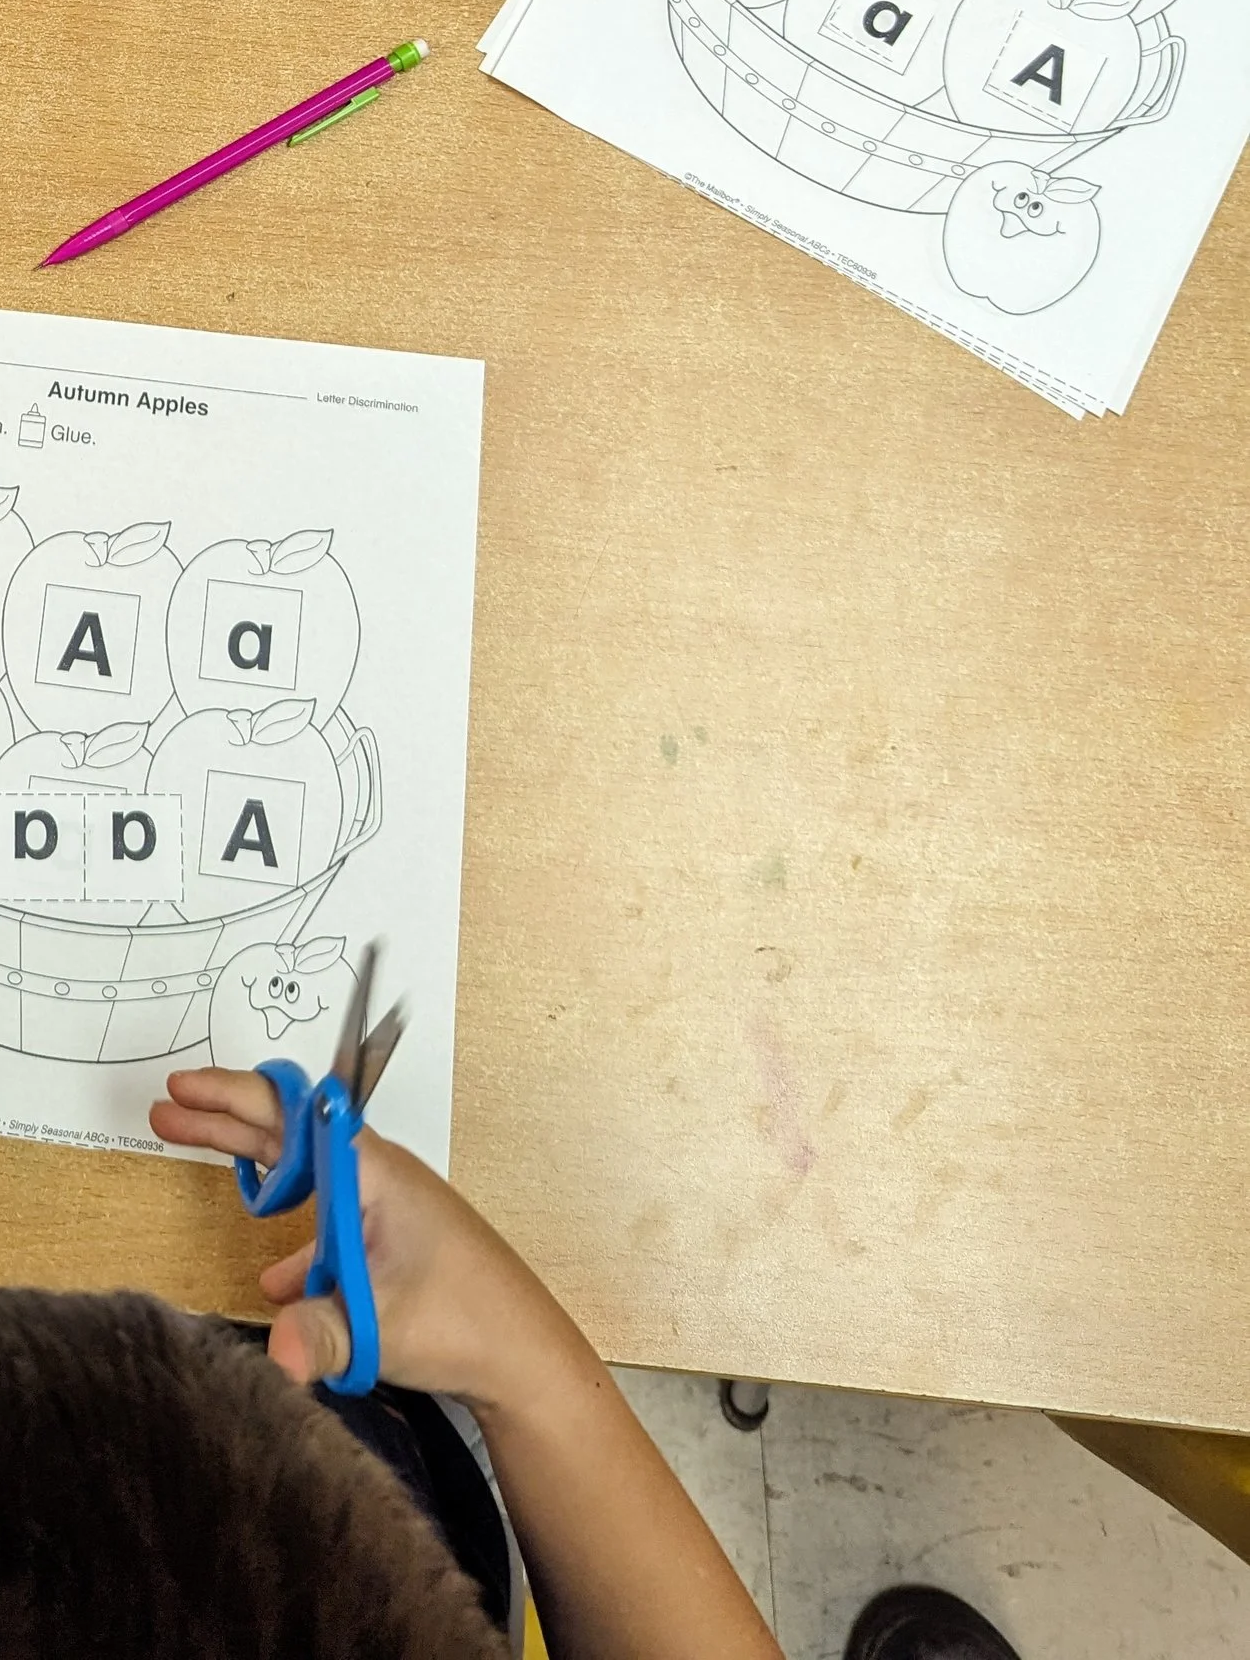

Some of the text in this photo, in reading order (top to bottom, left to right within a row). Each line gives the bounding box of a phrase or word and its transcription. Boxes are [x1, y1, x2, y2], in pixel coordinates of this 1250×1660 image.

[862, 0, 914, 47] a
[1010, 43, 1066, 106] A
[745, 204, 772, 224] Simply
[771, 220, 808, 244] Seasonal
[807, 236, 831, 255] ABCs
[48, 381, 209, 416] Autumn Apples
[316, 392, 419, 413] Letter Discrimination
[51, 424, 96, 445] Glue.
[56, 611, 112, 676] A
[227, 621, 273, 671] a
[14, 809, 58, 860] a
[111, 809, 157, 861] a
[221, 798, 279, 868] A
[9, 1119, 39, 1134] Simply
[41, 1124, 83, 1140] Seasonal
[83, 1131, 110, 1144] ABCs
[117, 1135, 164, 1152] TEC60936
